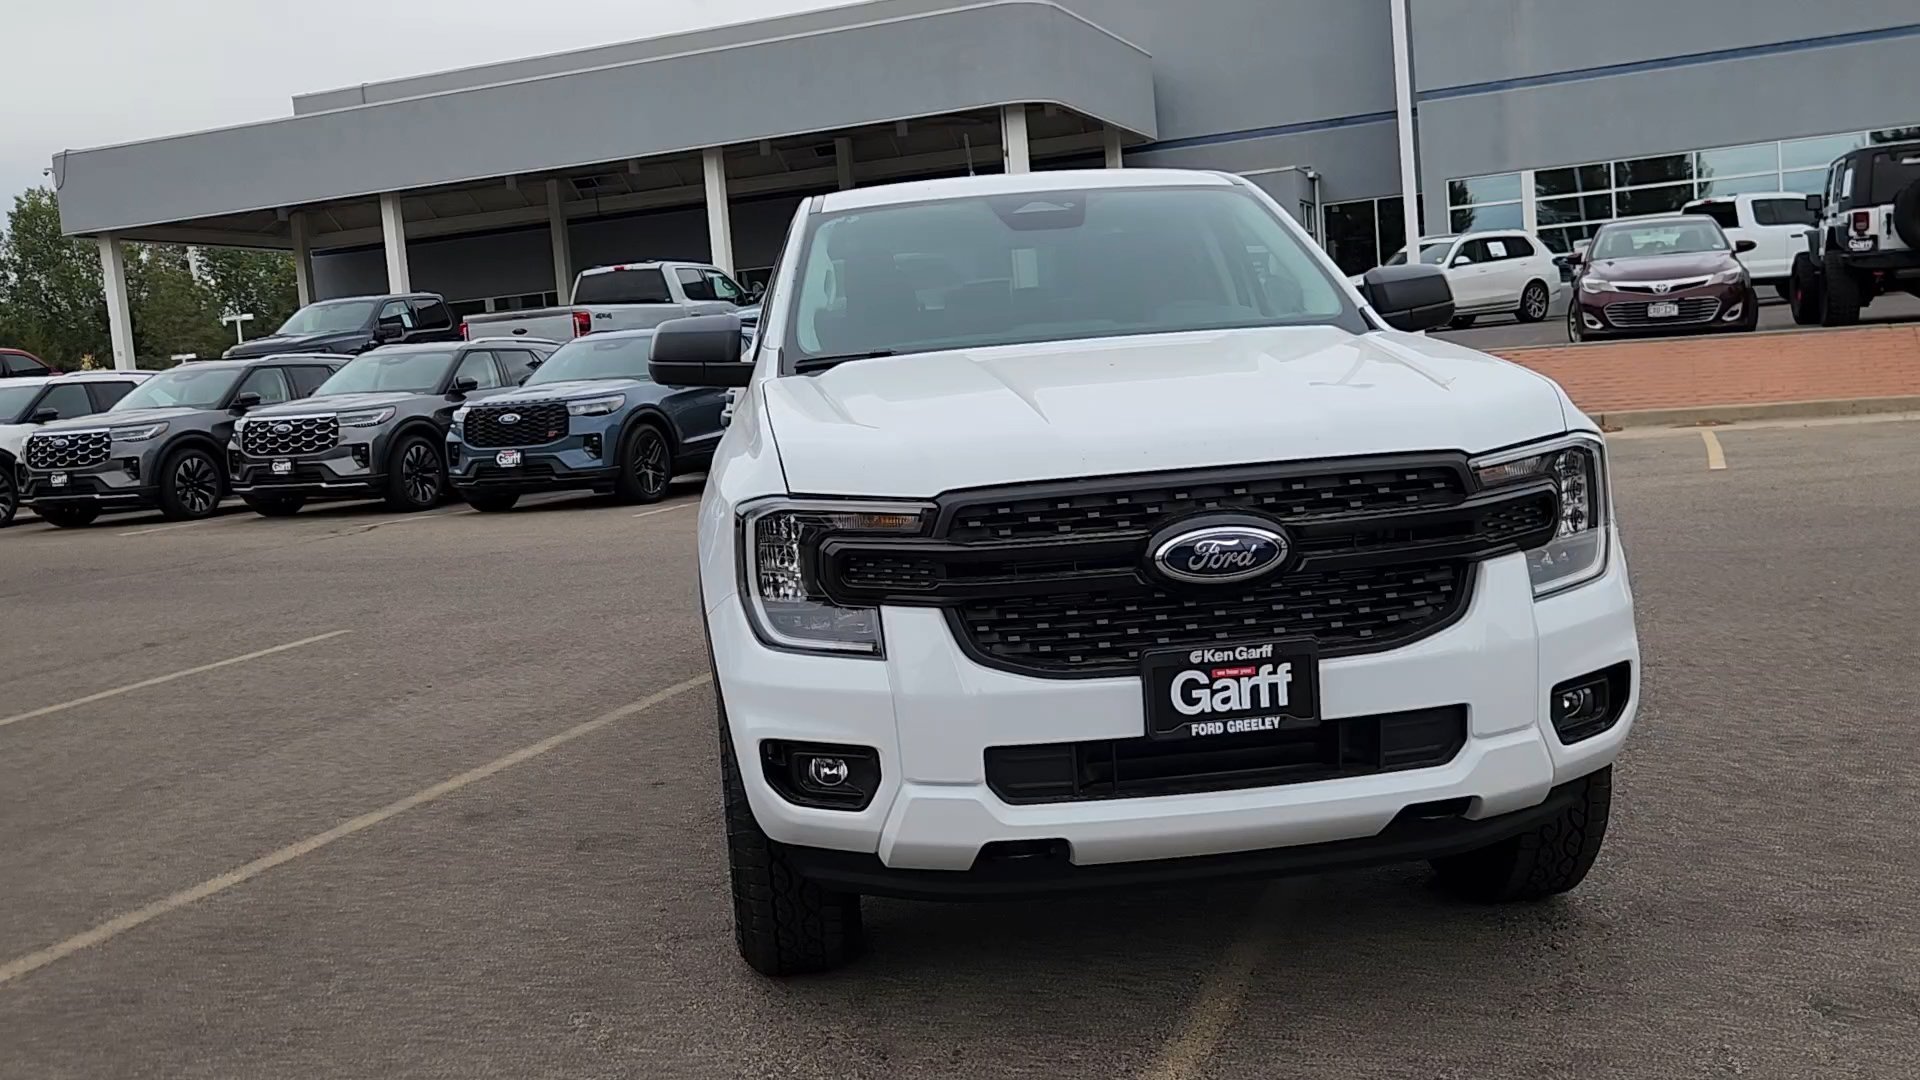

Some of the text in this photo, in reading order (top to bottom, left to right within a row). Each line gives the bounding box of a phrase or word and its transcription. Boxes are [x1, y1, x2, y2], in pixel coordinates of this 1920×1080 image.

[1188, 539, 1257, 571] Ford
[1203, 644, 1273, 663] Ken Garff
[1170, 662, 1293, 715] Garff
[1191, 716, 1281, 736] FORD GREELEY
